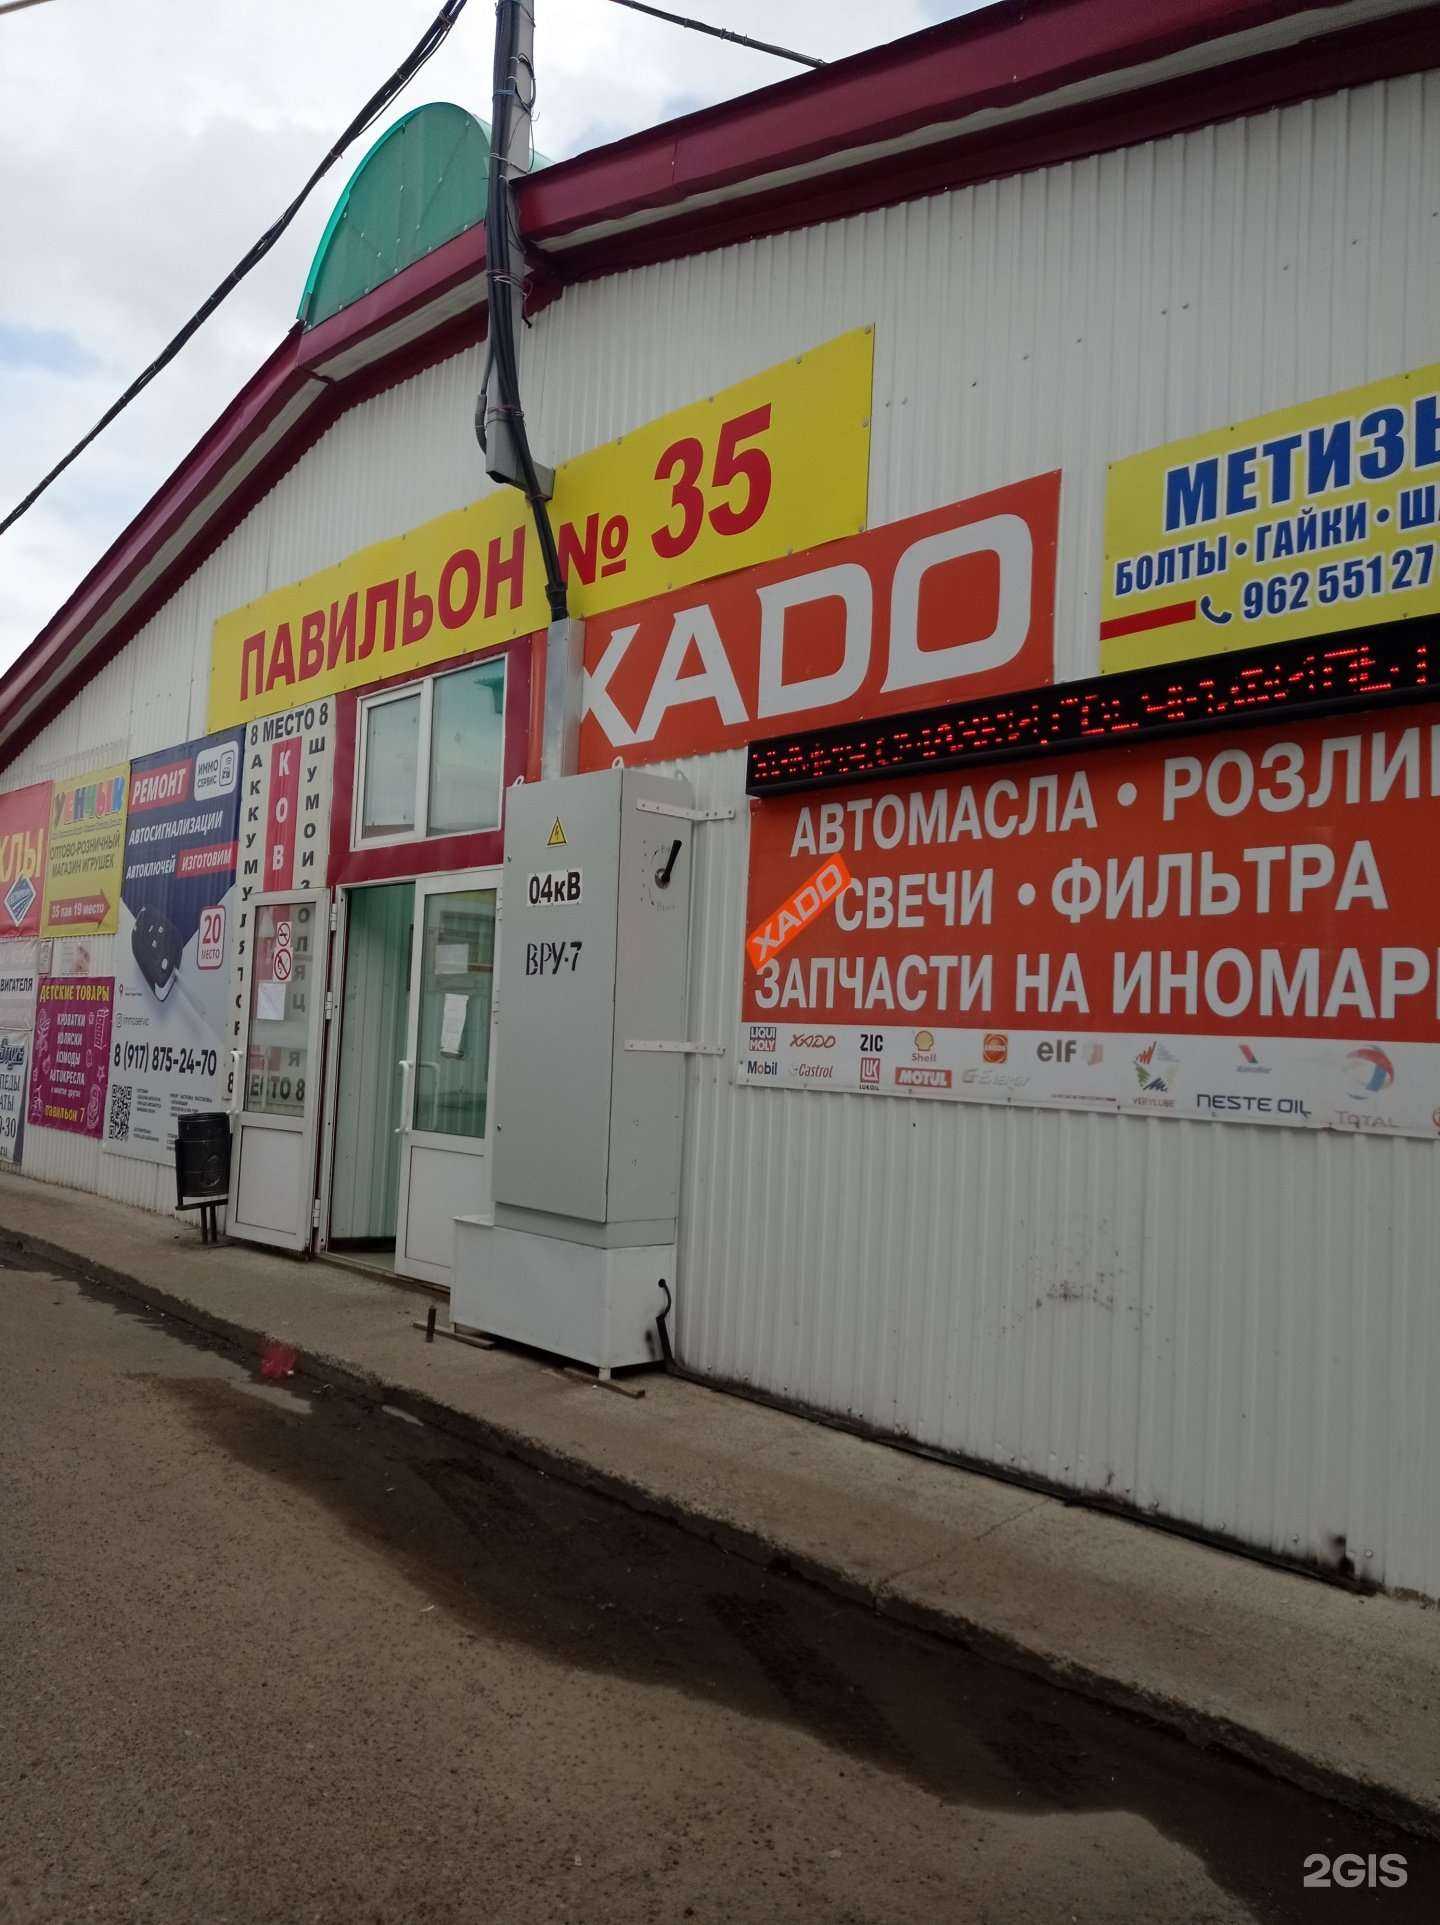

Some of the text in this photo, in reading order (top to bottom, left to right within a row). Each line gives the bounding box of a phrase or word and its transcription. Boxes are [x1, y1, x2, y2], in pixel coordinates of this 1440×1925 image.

[240, 525, 527, 701] ПАВИЛЬОН
[651, 402, 773, 560] 35
[1115, 484, 1440, 596] БОЛТЫ ГАЙКИ Ш
[1243, 544, 1434, 619] 962 551 27
[250, 703, 328, 746] 8 МЕСТО 8
[132, 768, 186, 805] РЕМОНТ
[1162, 724, 1440, 821] РОЗЛИ
[128, 810, 224, 846] АВТОСИГНАЛИЗАЦИИ
[790, 771, 1098, 857] АВТОМАСЛА
[126, 848, 232, 880] АВТОКЛЮЧЕЙ ИЗГОТОВИМ
[835, 840, 1389, 931] СВЕЧИ ФИЛЬТРА
[752, 863, 843, 961] XADO
[202, 914, 222, 944] 20
[200, 948, 220, 961] МЕСТО
[40, 984, 110, 1003] ДЕТСКИЕ ТОВАРЫ
[754, 947, 1440, 1019] ЗАПЧАСТИ НА ИНОМАР
[750, 1027, 776, 1040] LIQUI
[750, 1039, 776, 1052] MOLY
[790, 1033, 836, 1049] XADO
[860, 1034, 883, 1052] ZIC
[114, 1041, 217, 1076] 8 (917) 875-24-70
[912, 1052, 937, 1063] Shell
[1036, 1039, 1077, 1063] elf
[747, 1060, 778, 1076] Mobil
[798, 1063, 834, 1079] Castrol
[898, 1070, 947, 1087] MOTUL
[1196, 1093, 1312, 1119] NESTE OIL
